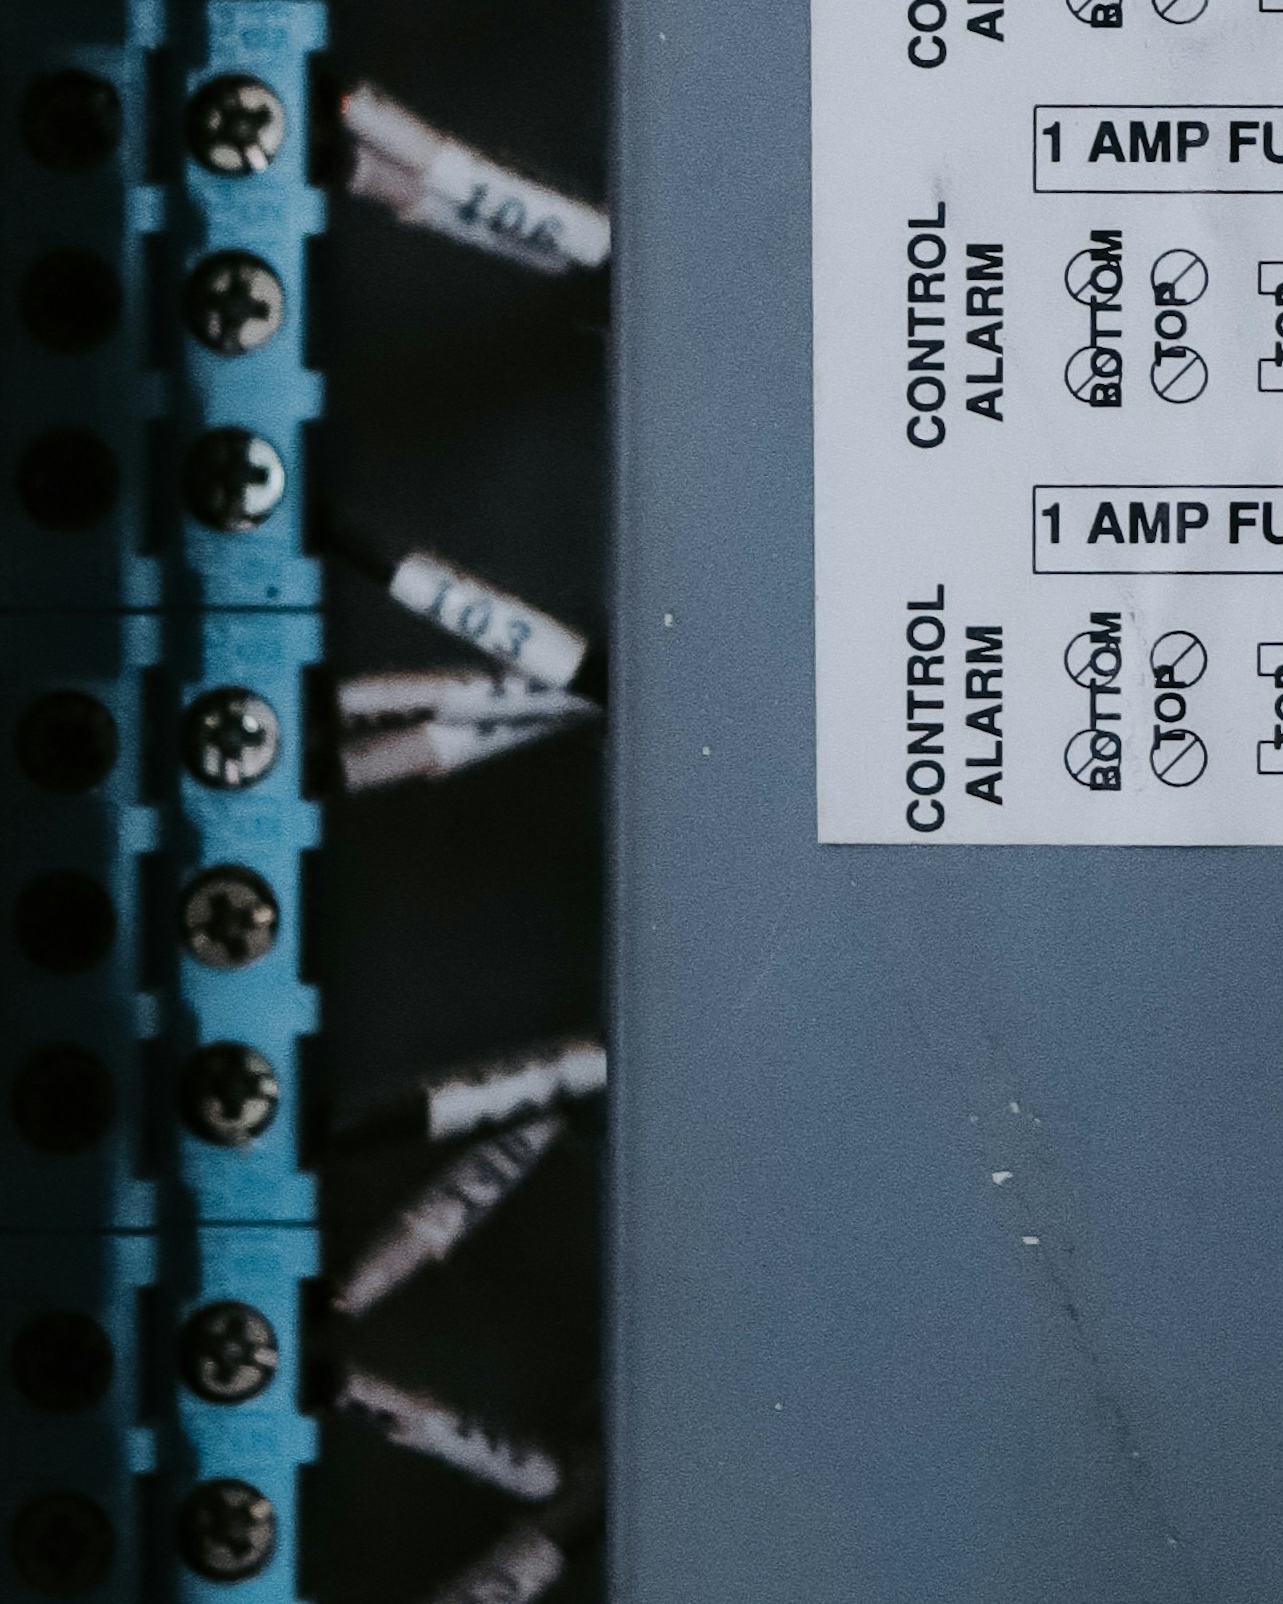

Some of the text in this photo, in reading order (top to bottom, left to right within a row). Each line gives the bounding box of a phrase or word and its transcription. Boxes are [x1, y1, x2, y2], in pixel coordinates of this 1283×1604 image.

[1041, 121, 1063, 163] 1
[1088, 121, 1209, 162] AMP
[907, 201, 946, 448] CONTROL
[966, 244, 1003, 421] ALARM
[1090, 231, 1121, 407] BOTTOM
[1154, 282, 1187, 365] TOP
[1041, 501, 1063, 545] 1
[1088, 502, 1209, 544] AMP
[906, 584, 945, 832] CONTROL
[966, 627, 1003, 805] ALARM
[1089, 612, 1120, 791] BOTTOM
[1153, 664, 1186, 749] TOP
